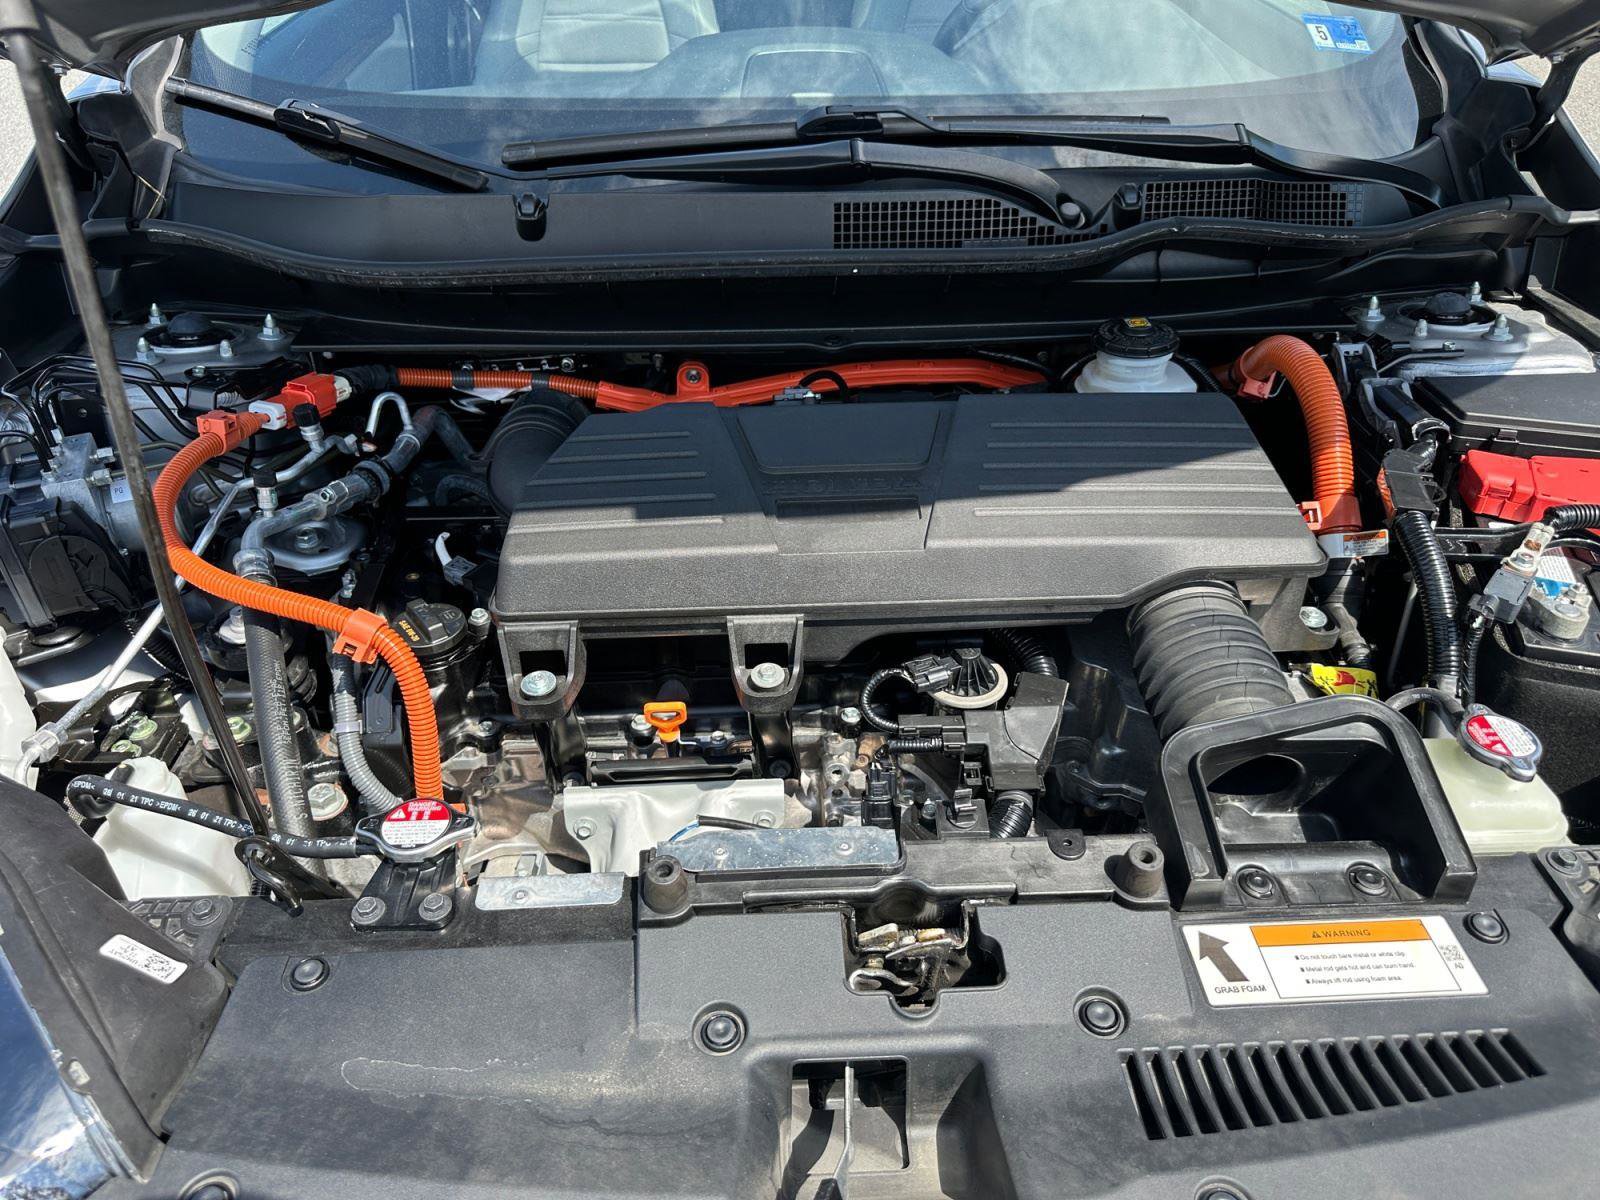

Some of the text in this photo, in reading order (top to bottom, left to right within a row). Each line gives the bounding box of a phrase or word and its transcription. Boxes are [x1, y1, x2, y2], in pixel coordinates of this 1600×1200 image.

[1315, 25, 1328, 40] 5
[116, 791, 126, 800] 01
[129, 794, 139, 803] 21
[140, 796, 154, 806] TPC
[200, 811, 210, 820] 01
[223, 818, 237, 829] TPC
[1323, 929, 1371, 937] WARNING
[1214, 985, 1267, 994] GRAB FOAM
